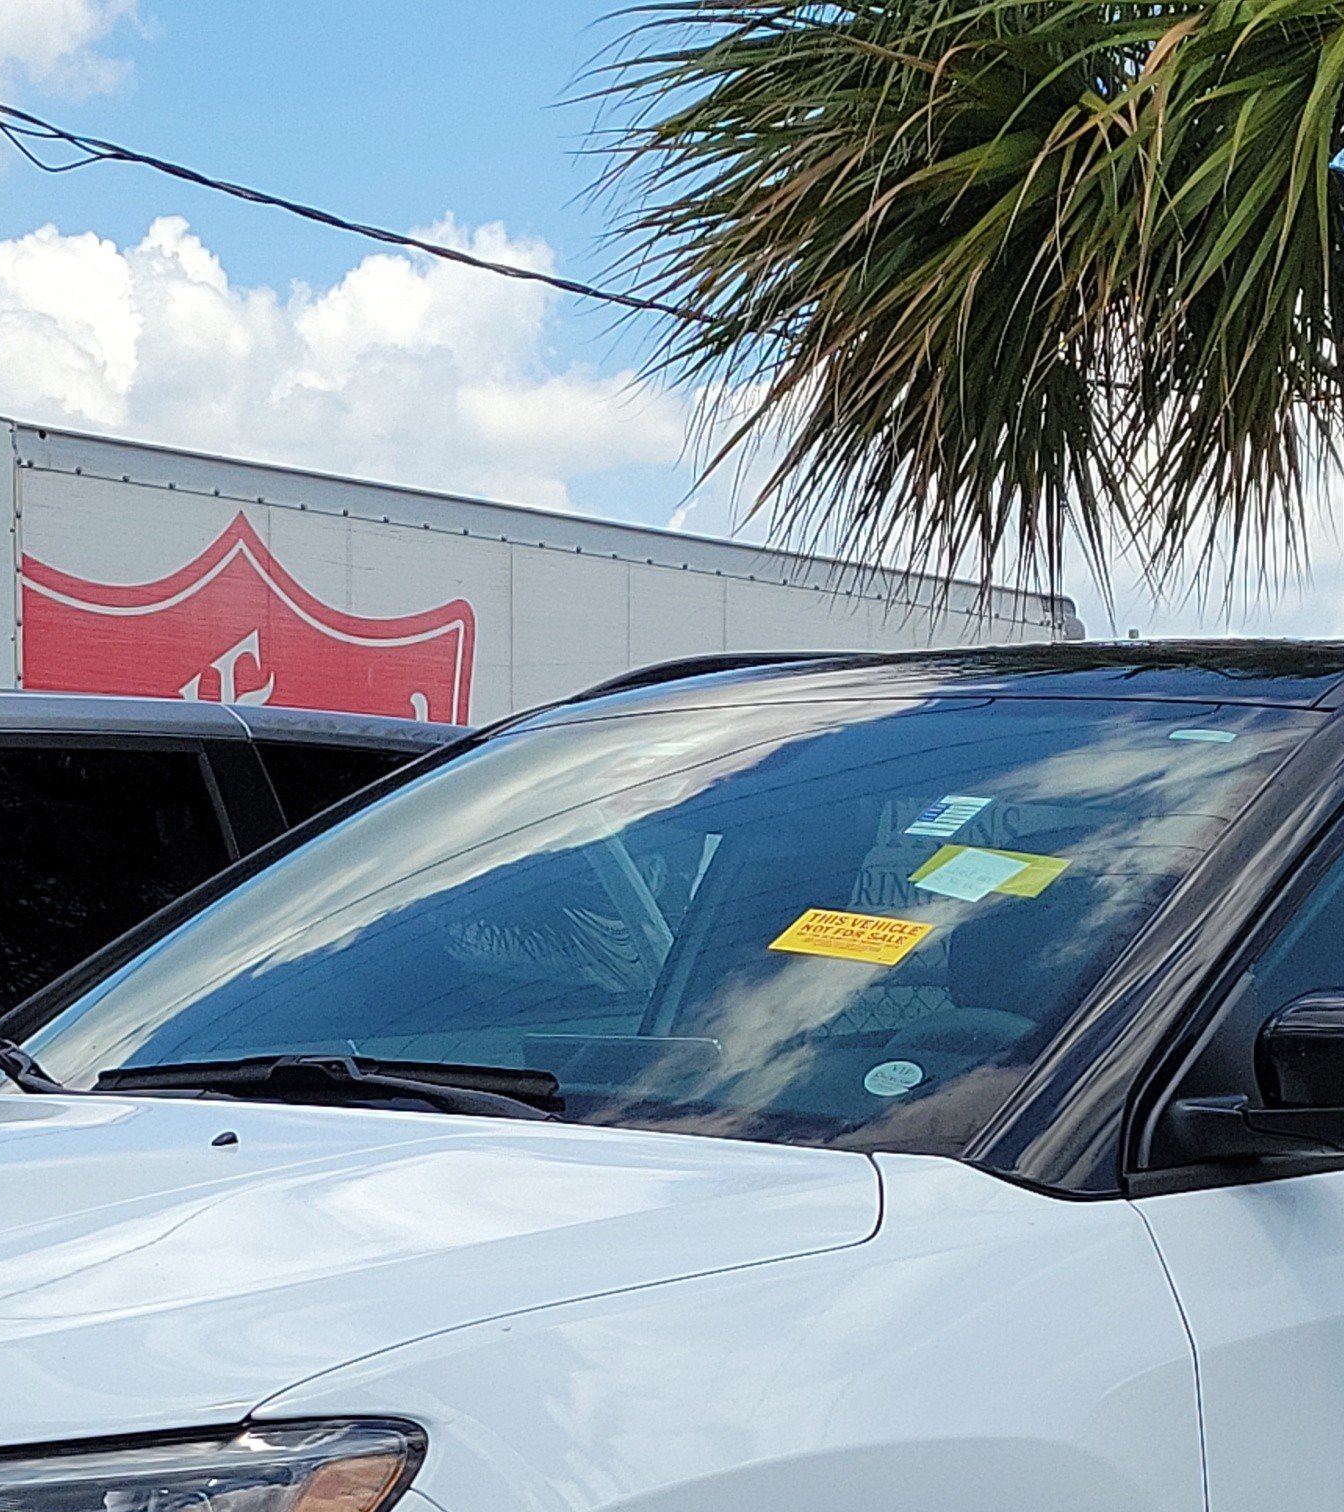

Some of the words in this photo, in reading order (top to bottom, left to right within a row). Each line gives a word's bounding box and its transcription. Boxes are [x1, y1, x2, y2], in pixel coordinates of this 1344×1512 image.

[800, 923, 834, 935] NOT
[832, 926, 866, 940] FOR
[867, 931, 909, 945] SALE
[807, 912, 849, 927] THIS
[850, 916, 923, 936] VEHICLE
